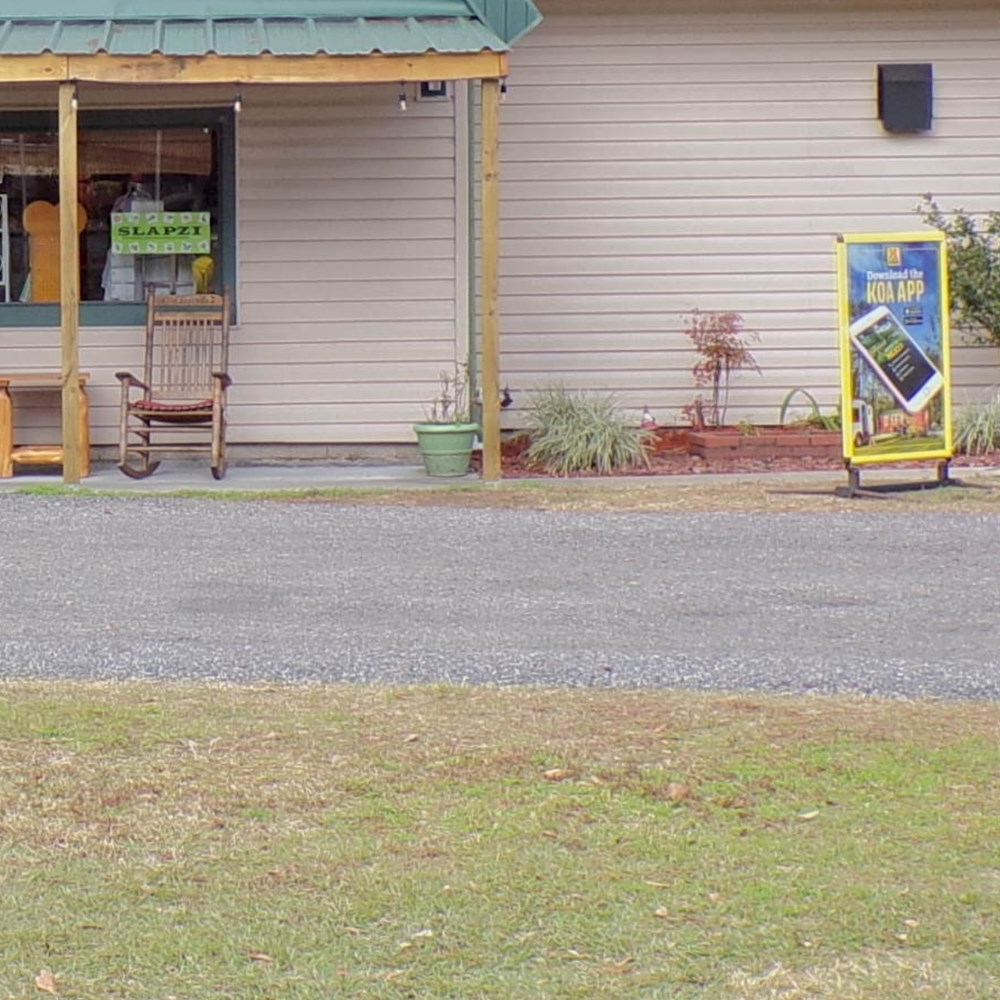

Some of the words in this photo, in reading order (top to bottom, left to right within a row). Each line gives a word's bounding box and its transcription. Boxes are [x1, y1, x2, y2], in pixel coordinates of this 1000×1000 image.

[118, 226, 201, 236] SLAPZI
[867, 269, 908, 280] Download
[909, 268, 924, 279] the
[867, 281, 895, 304] KOA
[897, 280, 924, 302] APP
